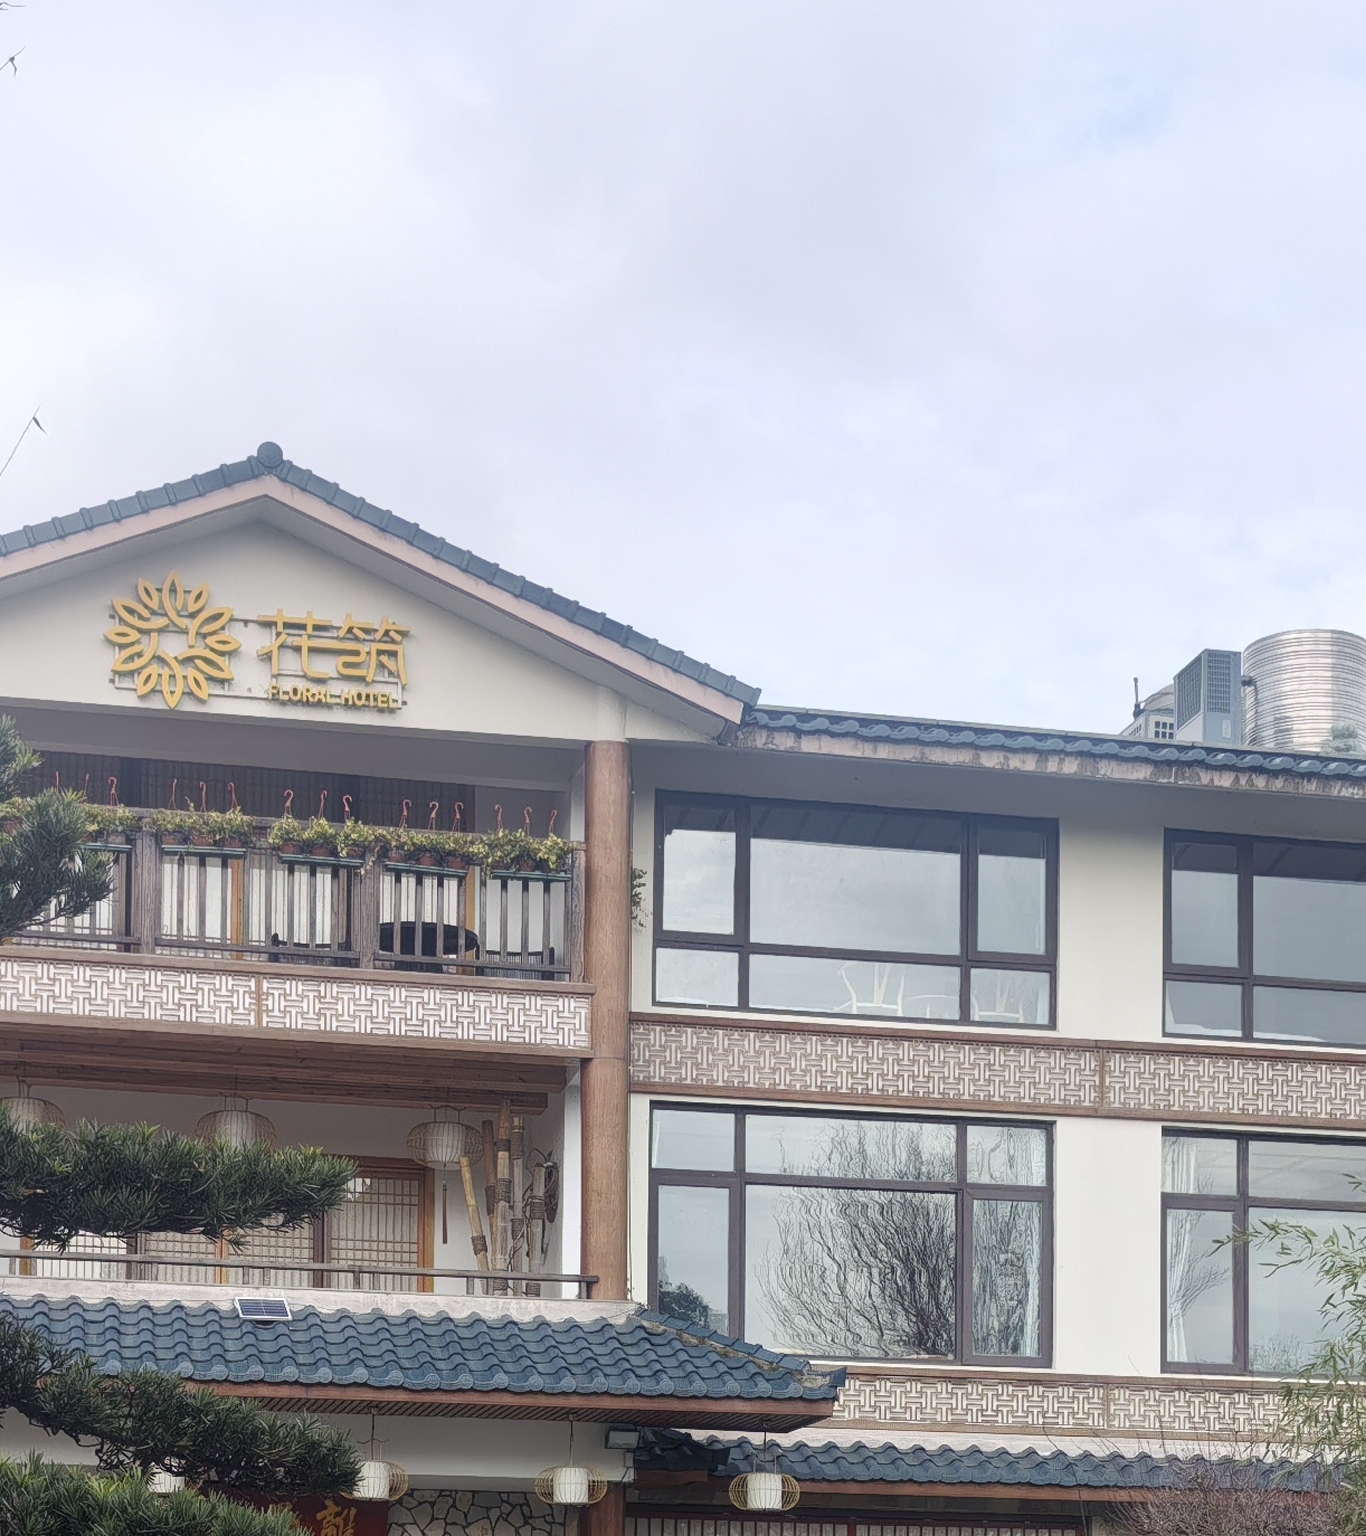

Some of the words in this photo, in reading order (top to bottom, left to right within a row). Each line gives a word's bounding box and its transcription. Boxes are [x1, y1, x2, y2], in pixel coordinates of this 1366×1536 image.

[257, 608, 411, 686] 花筑
[268, 683, 336, 703] FLORAL
[340, 688, 399, 708] HOTEL
